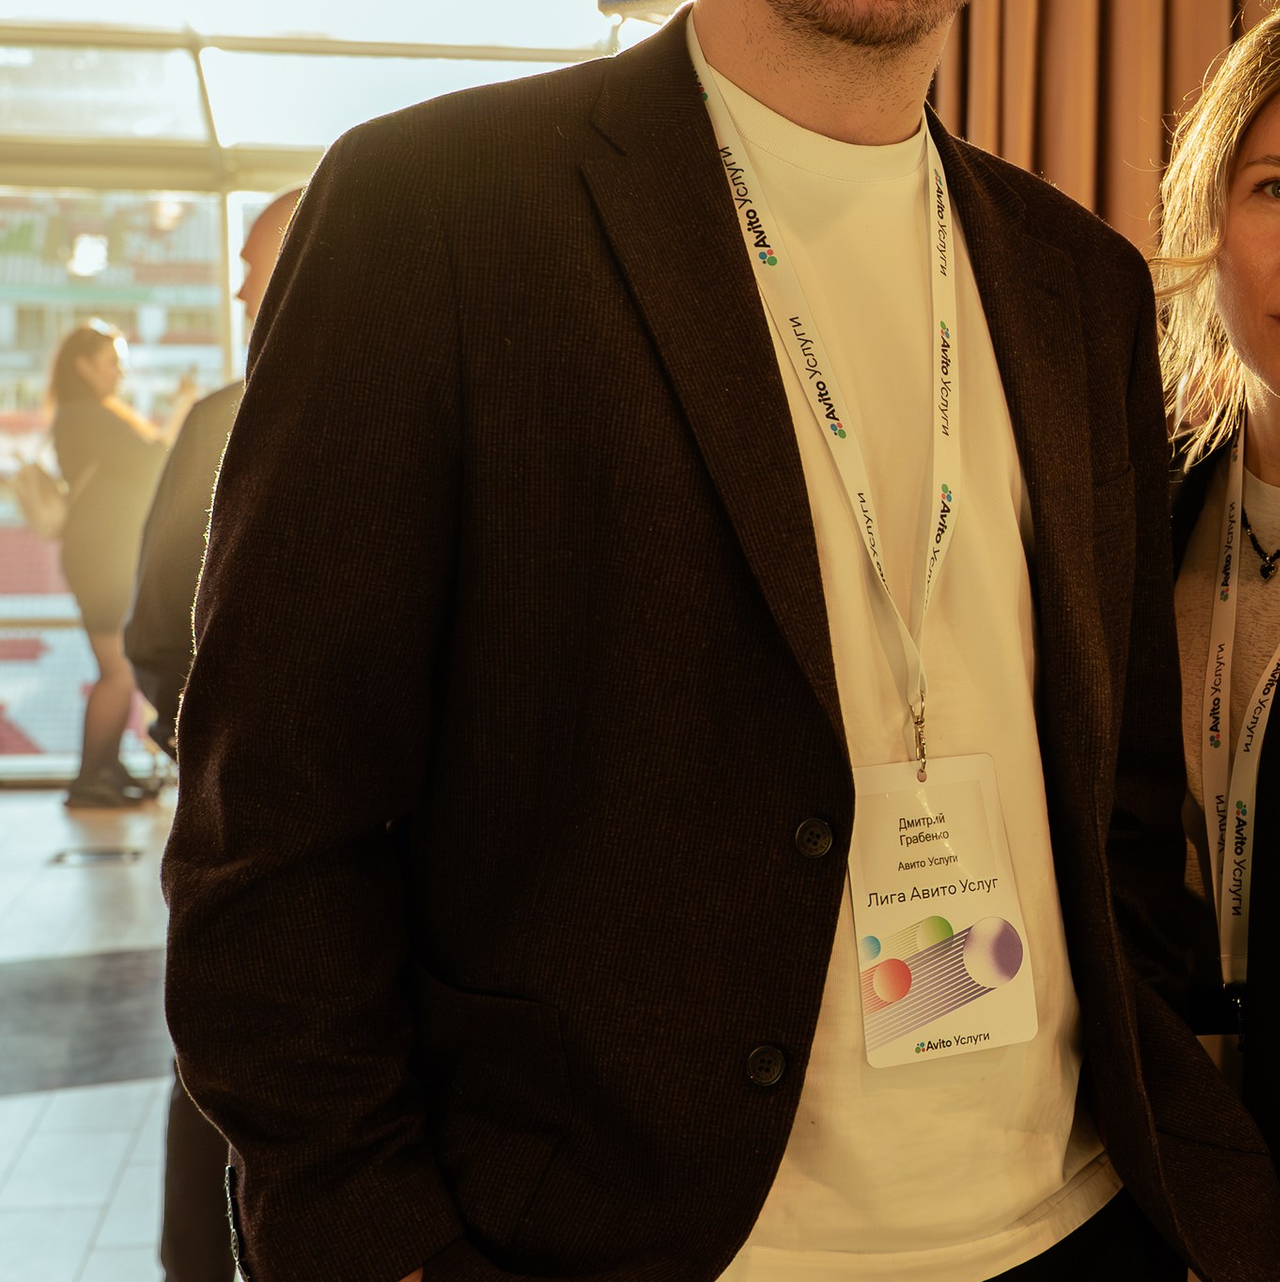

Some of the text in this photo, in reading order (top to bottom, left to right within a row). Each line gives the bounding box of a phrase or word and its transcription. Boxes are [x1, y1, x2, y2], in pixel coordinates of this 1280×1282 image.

[719, 146, 772, 249] Avito Услуги
[932, 183, 948, 277] Avito Услуги
[789, 316, 841, 422] Avito Услуги
[937, 336, 952, 437] Avito Услуги
[857, 492, 879, 558] Услуги
[935, 500, 951, 544] Avito
[1221, 501, 1236, 588] Avito Услуги
[1209, 643, 1226, 734] Avito Услуги
[1243, 697, 1269, 753] Услуги
[898, 812, 946, 831] Дмитрий
[899, 829, 950, 847] Грабенко
[867, 877, 999, 907] Лига Авито Услуг
[898, 853, 959, 871] Авито Услуги
[1229, 816, 1248, 916] Avito Услуги
[926, 1031, 990, 1051] Avito Услуги
